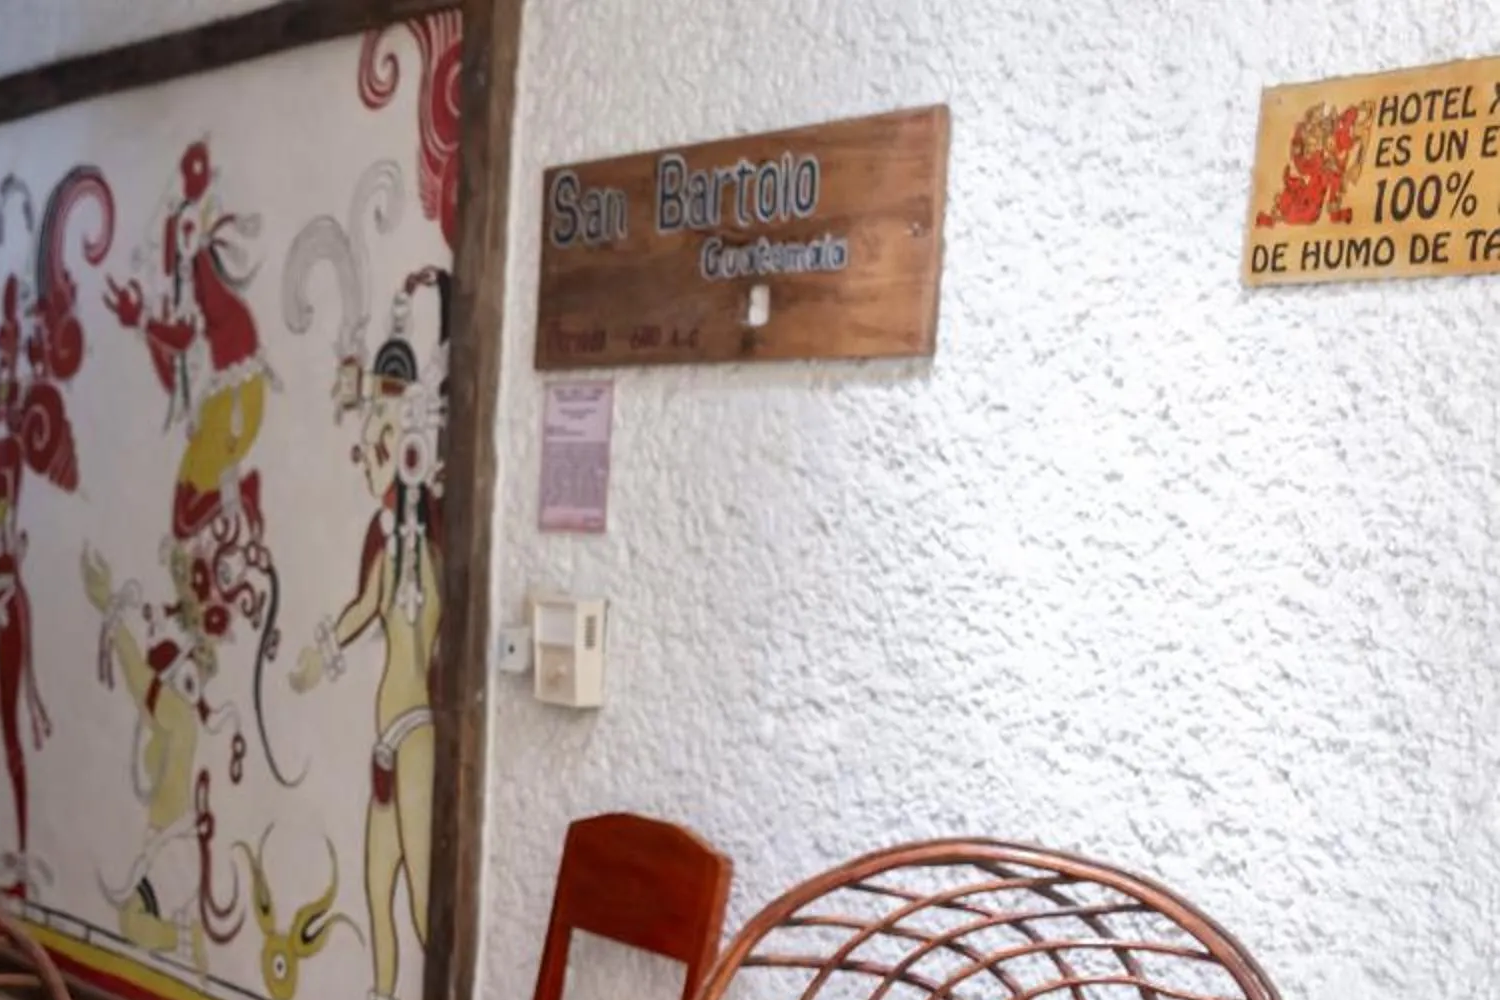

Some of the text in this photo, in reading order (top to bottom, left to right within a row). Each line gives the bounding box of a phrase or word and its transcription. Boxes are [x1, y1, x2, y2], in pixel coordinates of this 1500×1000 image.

[1377, 86, 1477, 128] HOTEL
[1375, 134, 1412, 168] ES
[1425, 128, 1468, 163] UN
[552, 152, 819, 245] San Bartolo
[1373, 169, 1477, 224] 100%
[1251, 241, 1289, 274] DE
[1301, 235, 1395, 271] HUMO
[1409, 231, 1450, 265] DE
